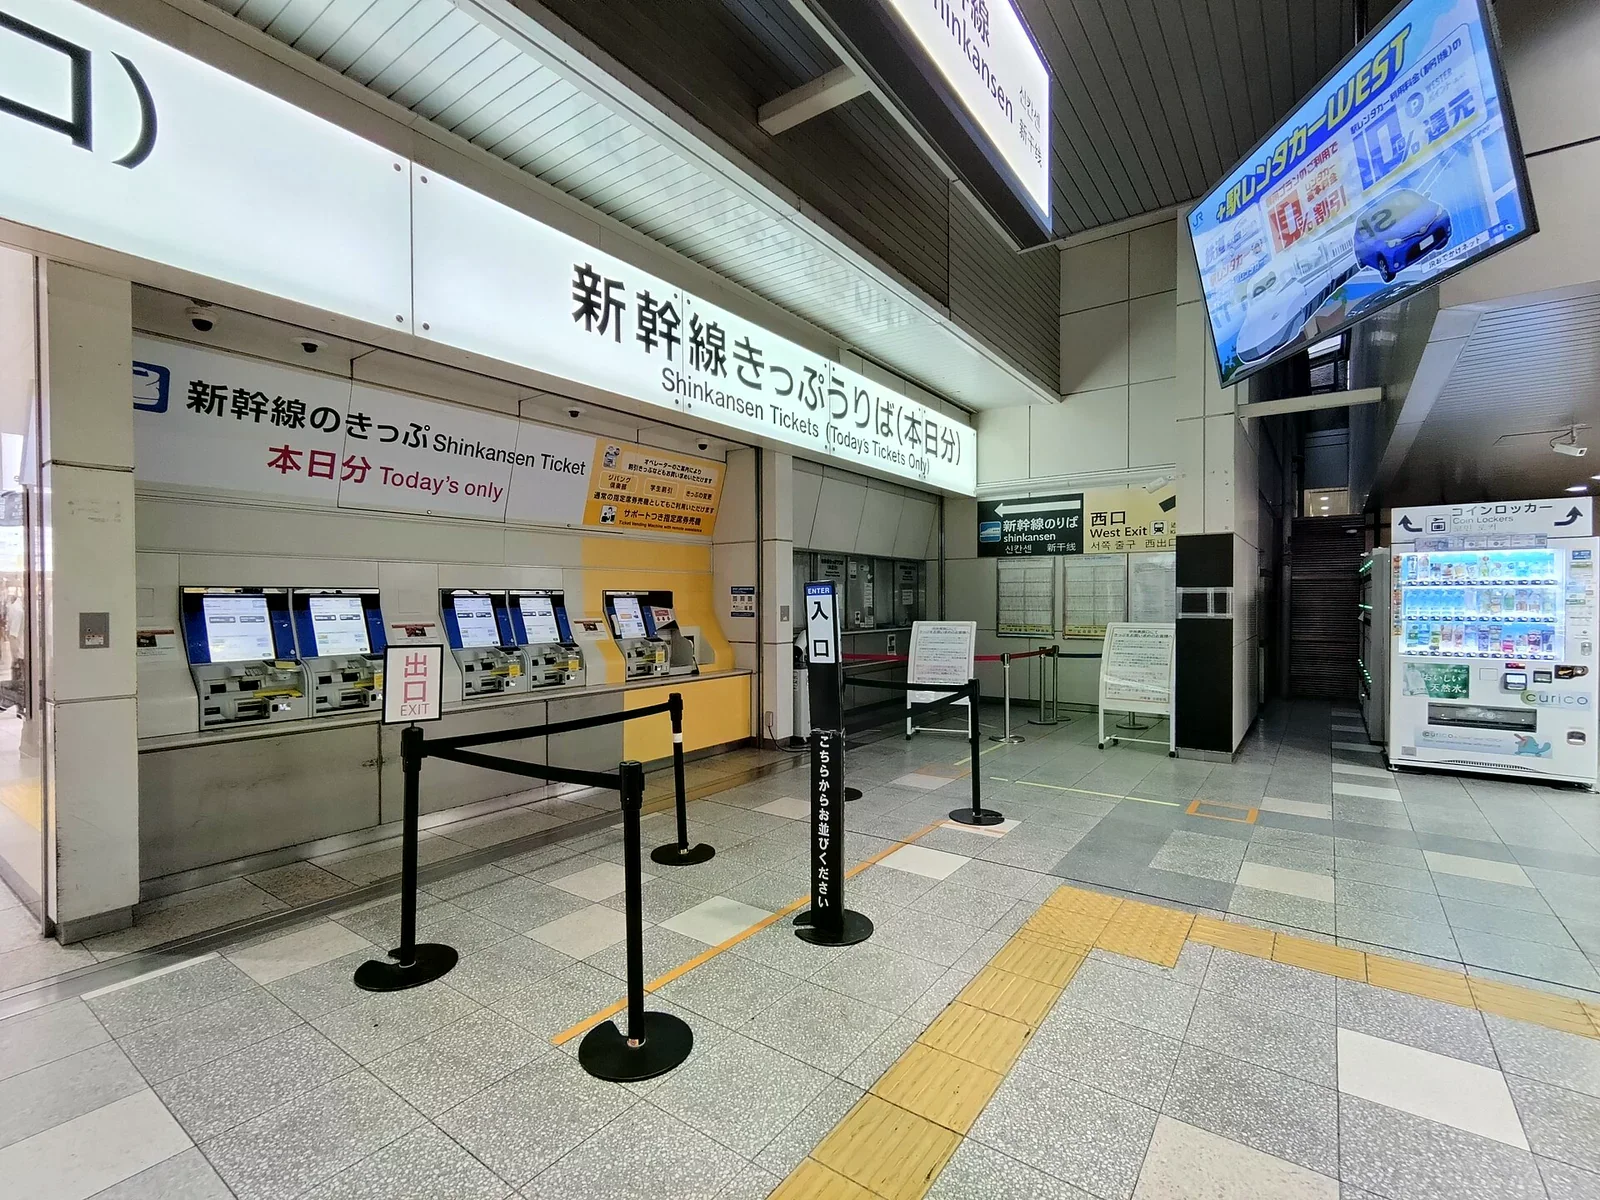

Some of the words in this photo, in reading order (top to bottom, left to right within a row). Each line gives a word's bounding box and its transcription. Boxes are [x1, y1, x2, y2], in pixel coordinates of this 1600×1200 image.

[961, 0, 990, 47] 線
[572, 262, 962, 467] 新幹線きっぷうりば(本日分)
[661, 367, 764, 422] Shinkansen
[769, 404, 820, 439] Tickets
[871, 439, 908, 466] Tickets
[186, 379, 431, 448] 新幹線のきっぷ
[432, 433, 536, 468] Shinkansen
[540, 453, 587, 475] Ticket
[267, 444, 373, 484] 本日分
[464, 481, 504, 503] only
[1452, 503, 1553, 517] コインロッカー
[1003, 515, 1079, 533] 新幹線のりば
[1090, 511, 1126, 527] 西口
[1452, 517, 1474, 525] Coin
[1476, 515, 1514, 524] Lockers
[1003, 532, 1056, 543] shinkansen
[1090, 528, 1121, 539] West
[1125, 526, 1148, 536] Exit
[1005, 544, 1032, 554] 신칸센
[807, 587, 830, 595] ENTER
[811, 601, 829, 657] 入口
[404, 652, 427, 703] 出口
[1525, 693, 1589, 705] curico
[400, 703, 430, 717] EXIT
[818, 735, 830, 908] こちらからお並びください
